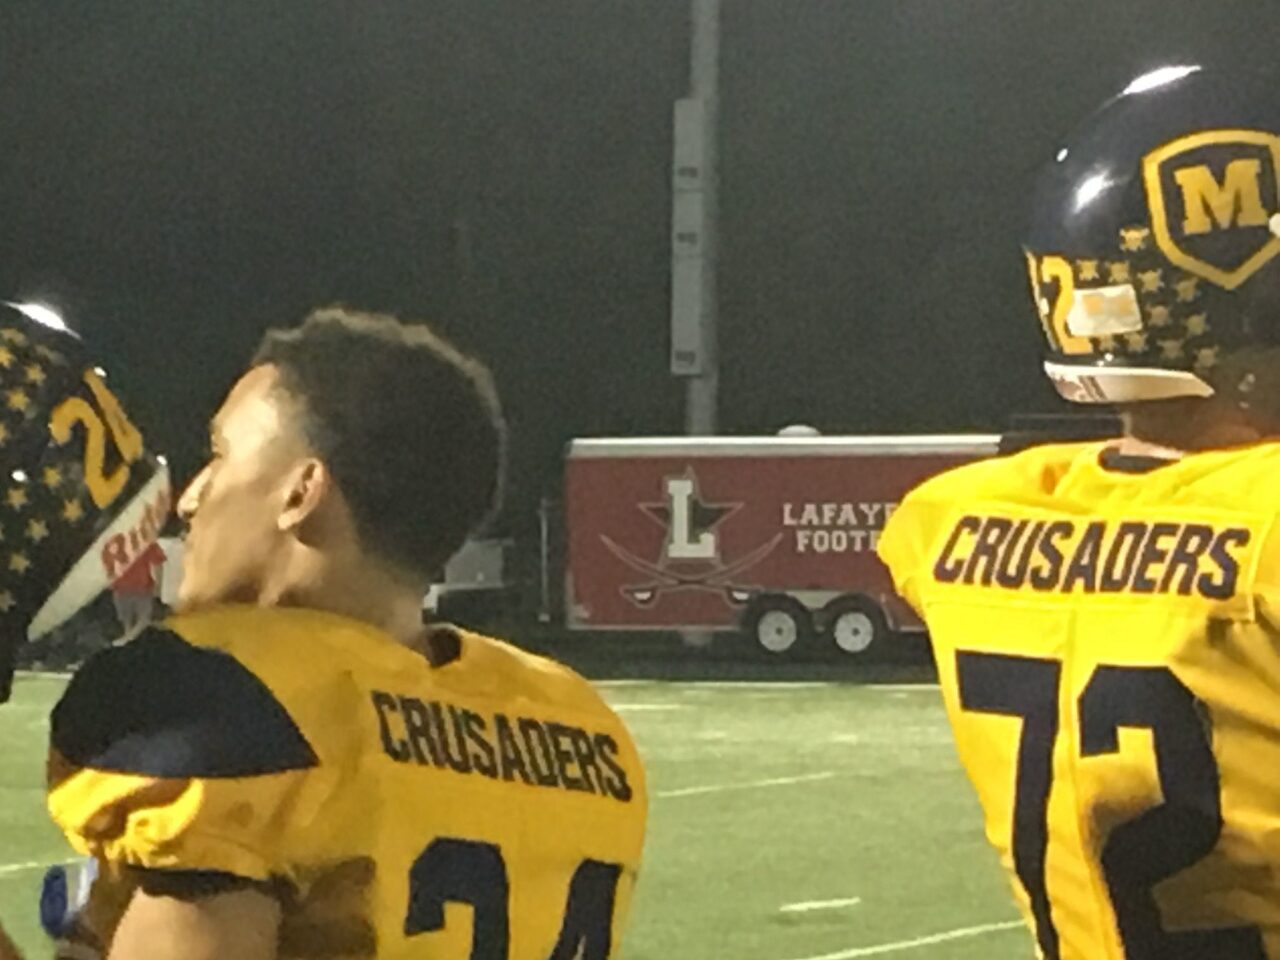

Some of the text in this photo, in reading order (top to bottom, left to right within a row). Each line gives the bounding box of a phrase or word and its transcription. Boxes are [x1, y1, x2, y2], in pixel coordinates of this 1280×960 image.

[1175, 159, 1269, 235] M
[668, 480, 715, 558] L
[933, 515, 1250, 600] CRUSADERS
[372, 690, 632, 801] CRUSADERS
